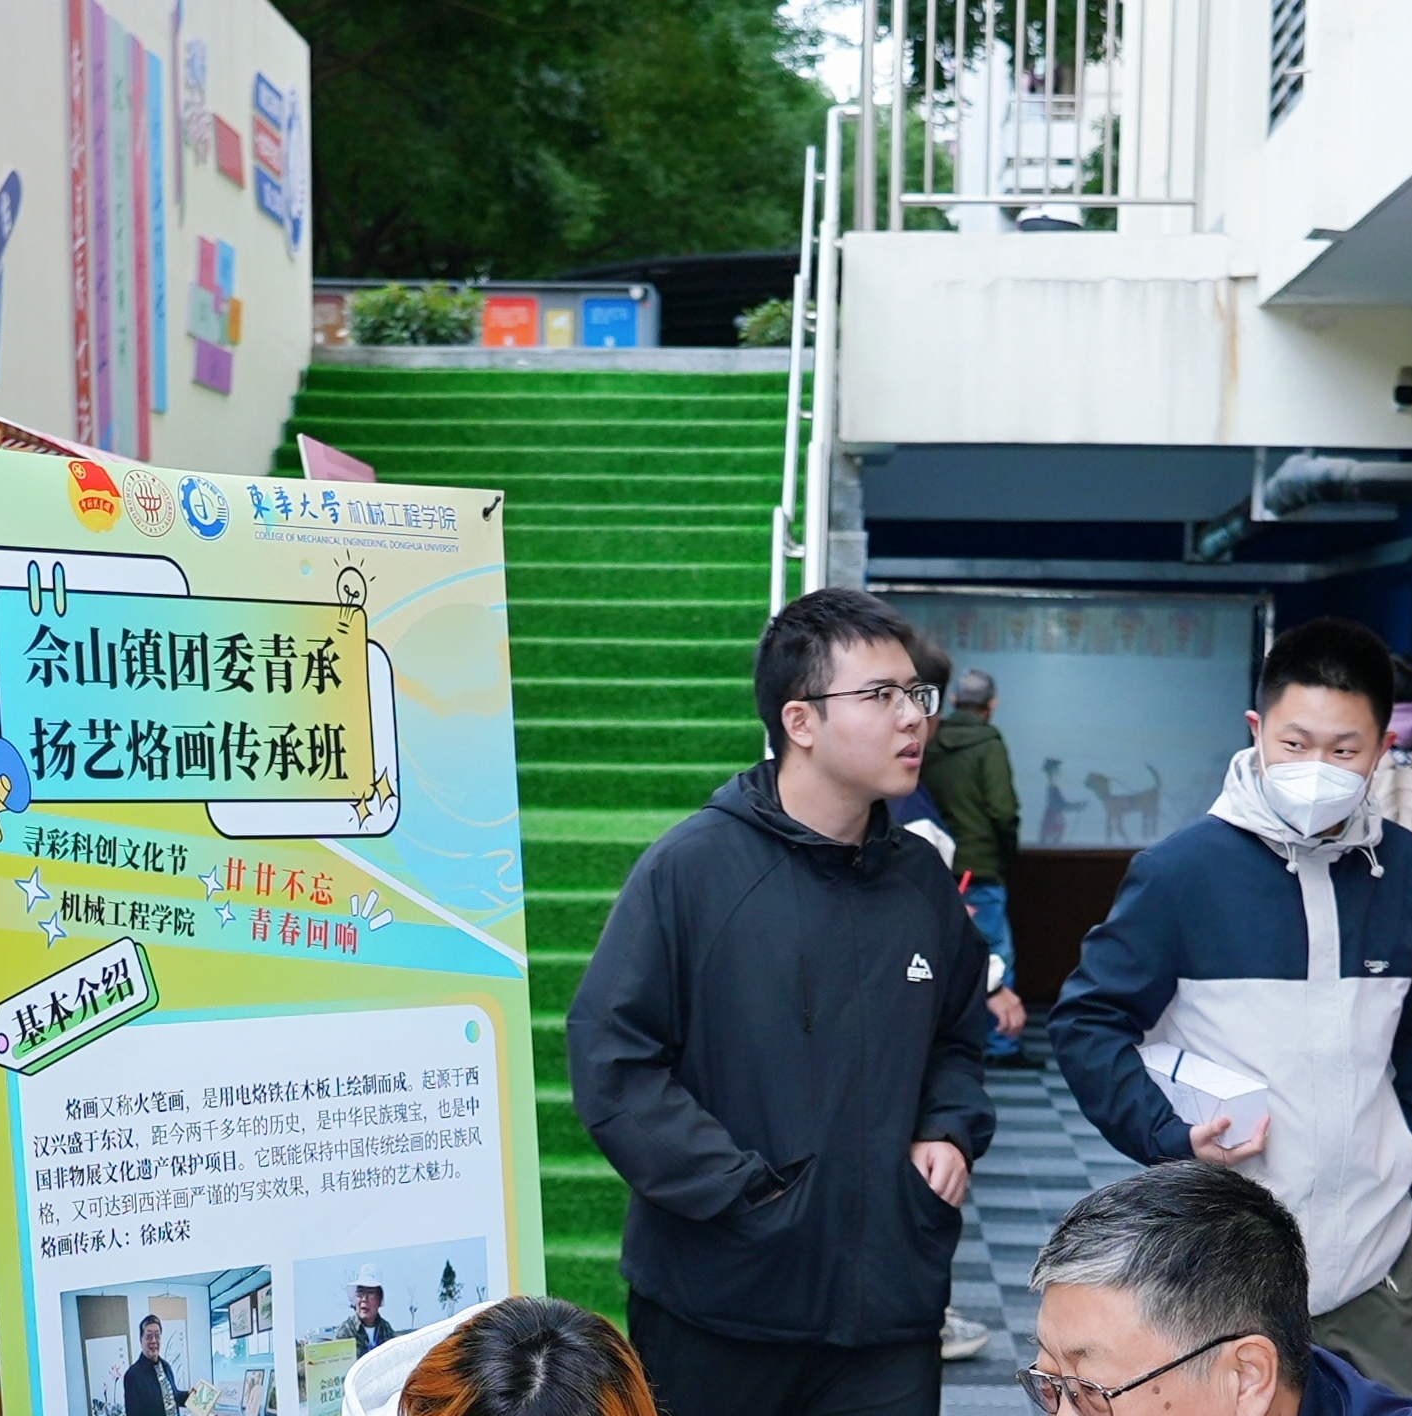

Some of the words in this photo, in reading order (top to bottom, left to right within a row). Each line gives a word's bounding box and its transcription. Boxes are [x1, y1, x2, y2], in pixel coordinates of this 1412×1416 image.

[347, 500, 458, 531] 机械工程学院
[254, 530, 284, 542] COLLEGE
[297, 534, 341, 545] MECHANICAL
[389, 540, 423, 551] DONGHUA
[424, 543, 459, 554] UNIVERSITY
[23, 623, 342, 695] 佘山镇团委青承
[29, 716, 349, 782] 扬艺烙画传承班
[22, 825, 189, 876] 寻彩科创文化节
[60, 891, 195, 937] 机械工程学院
[249, 907, 358, 956] 青春回响
[12, 957, 134, 1052] 基本介绍
